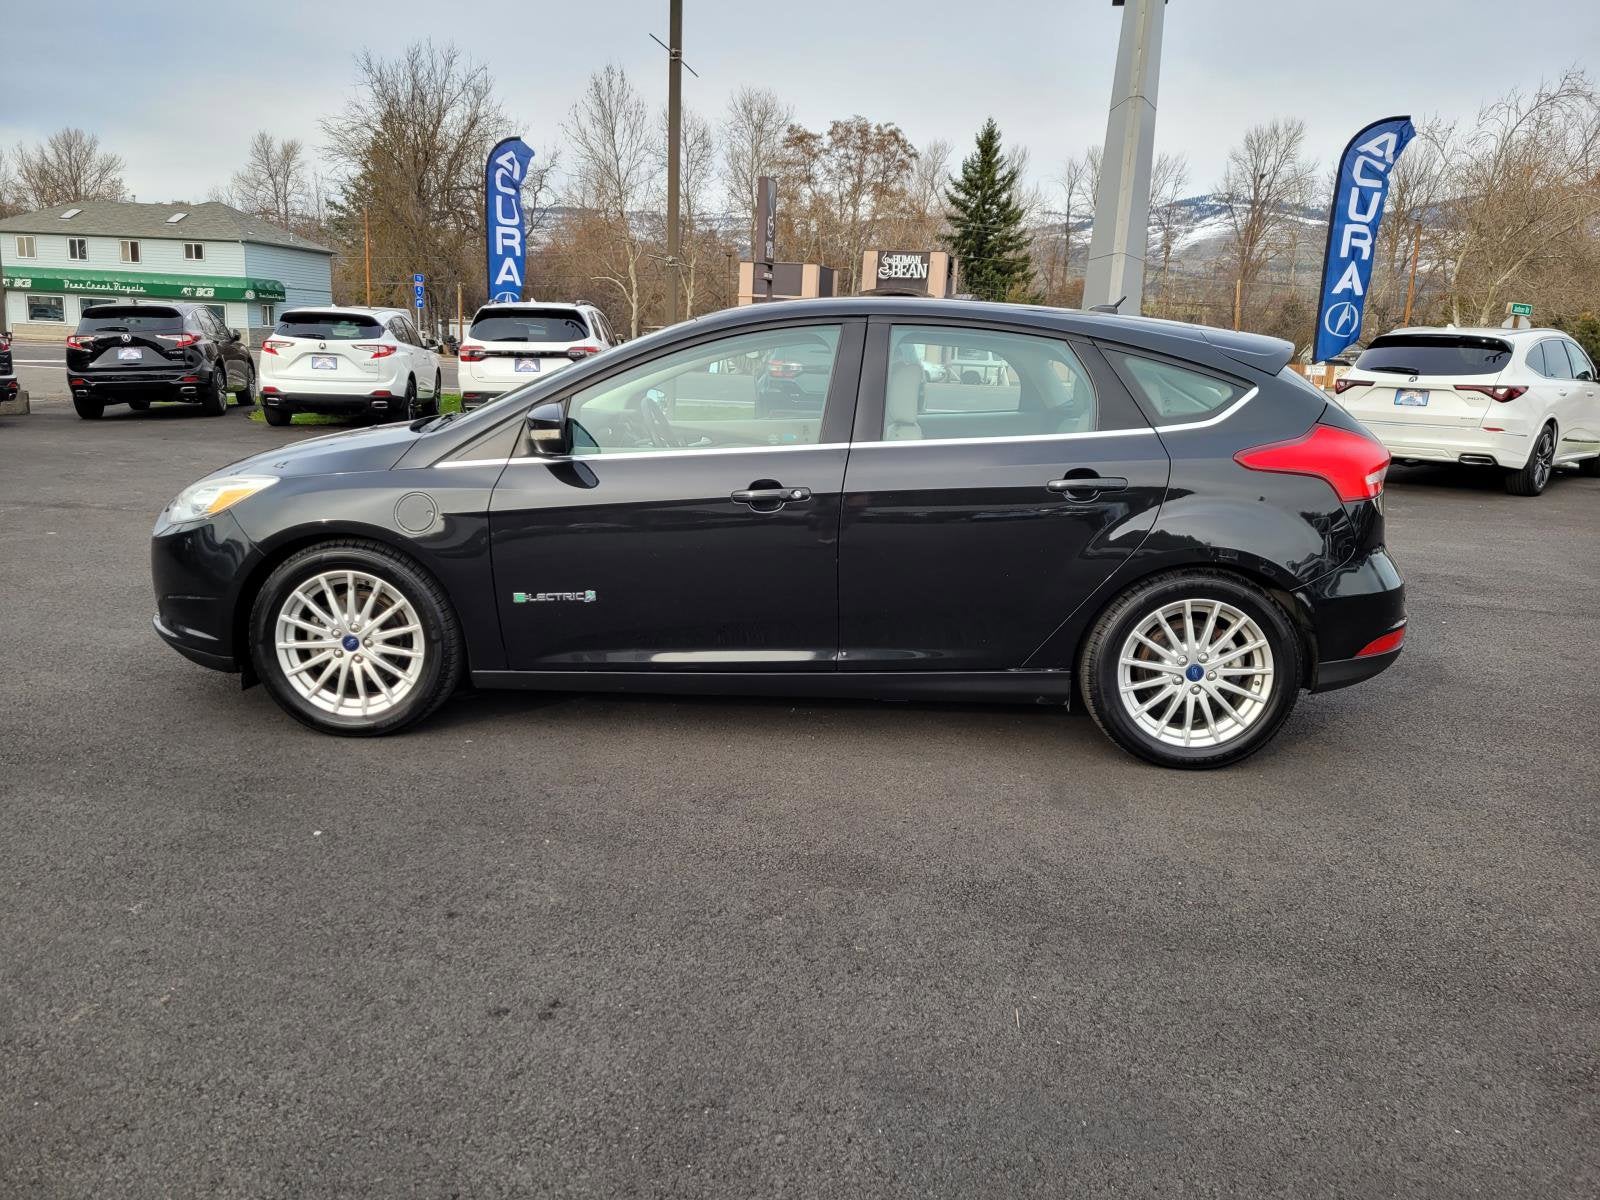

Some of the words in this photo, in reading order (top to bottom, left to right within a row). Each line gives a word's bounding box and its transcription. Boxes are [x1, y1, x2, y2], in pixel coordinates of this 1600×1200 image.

[495, 150, 522, 287] ACURA
[891, 263, 929, 279] BEAN
[1331, 131, 1398, 296] ACURA
